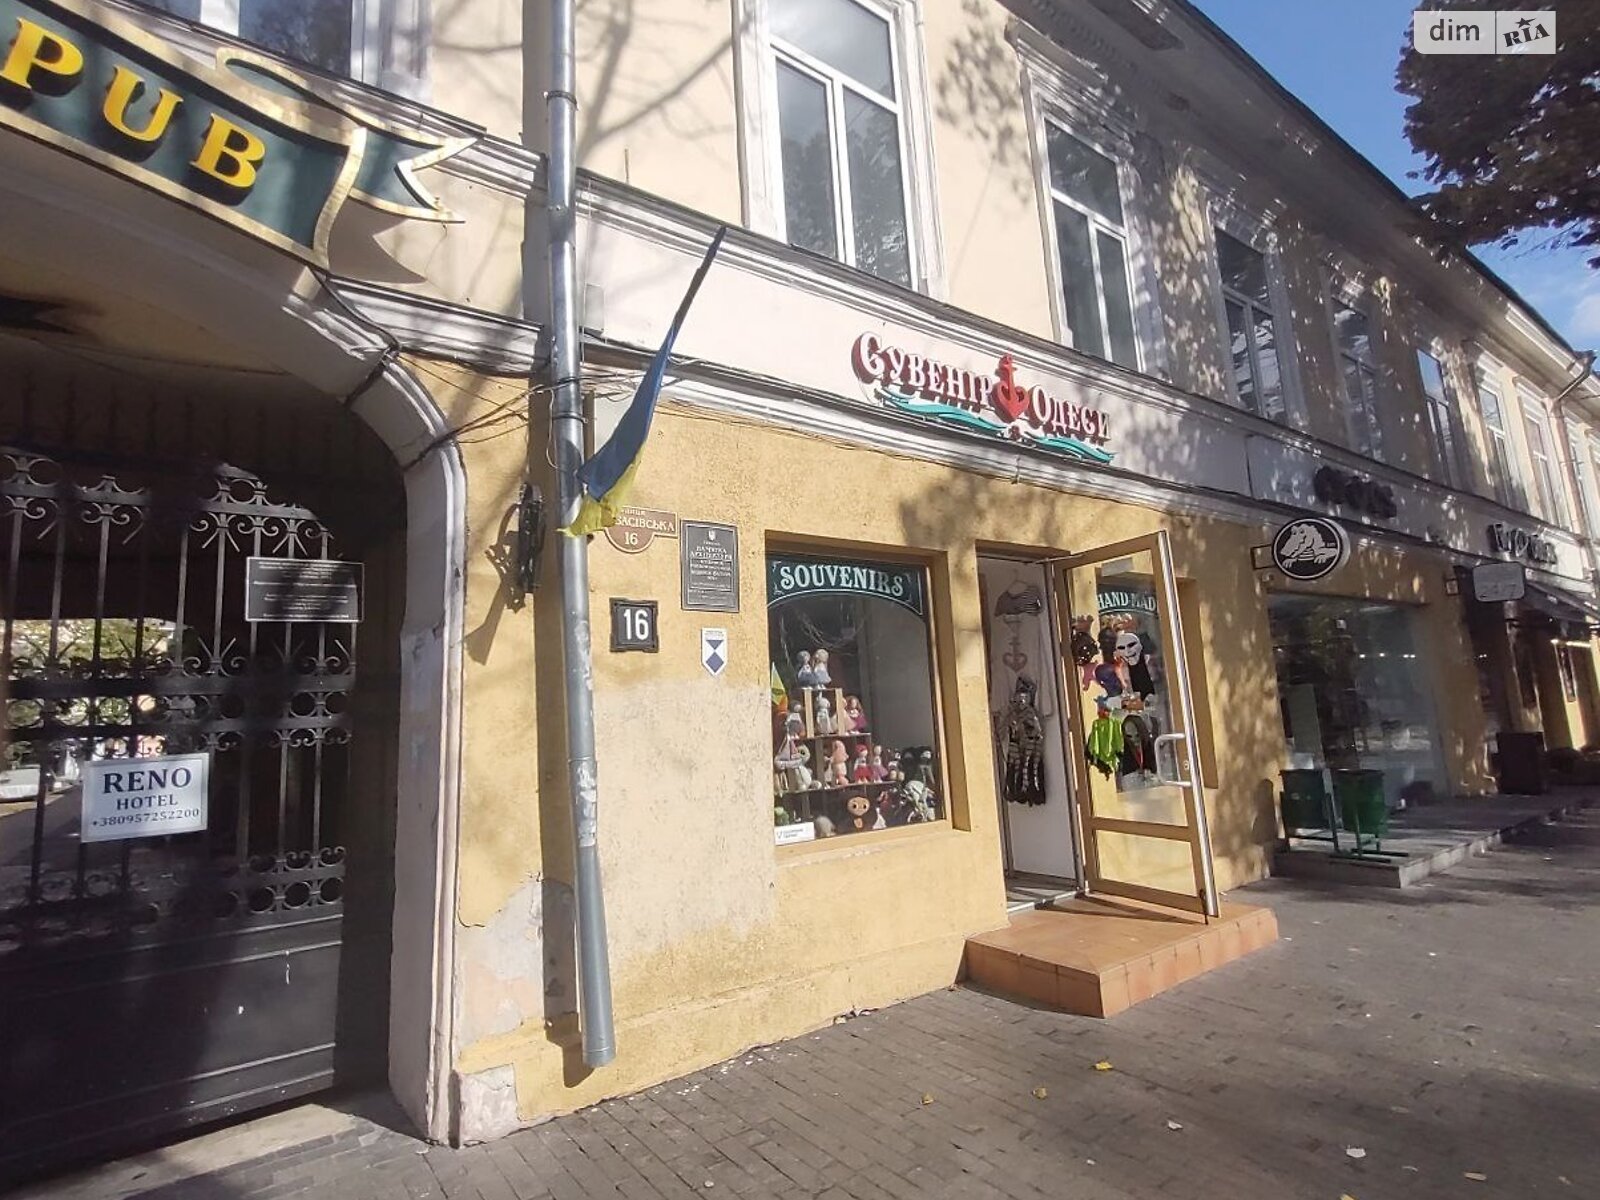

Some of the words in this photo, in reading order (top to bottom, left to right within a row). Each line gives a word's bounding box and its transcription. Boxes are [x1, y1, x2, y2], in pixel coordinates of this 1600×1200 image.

[1, 17, 266, 189] PUB
[624, 531, 638, 546] 16
[780, 564, 904, 597] SOUVENIRS
[623, 608, 649, 640] 16
[103, 767, 192, 794] RENO
[116, 793, 178, 811] HOTEL
